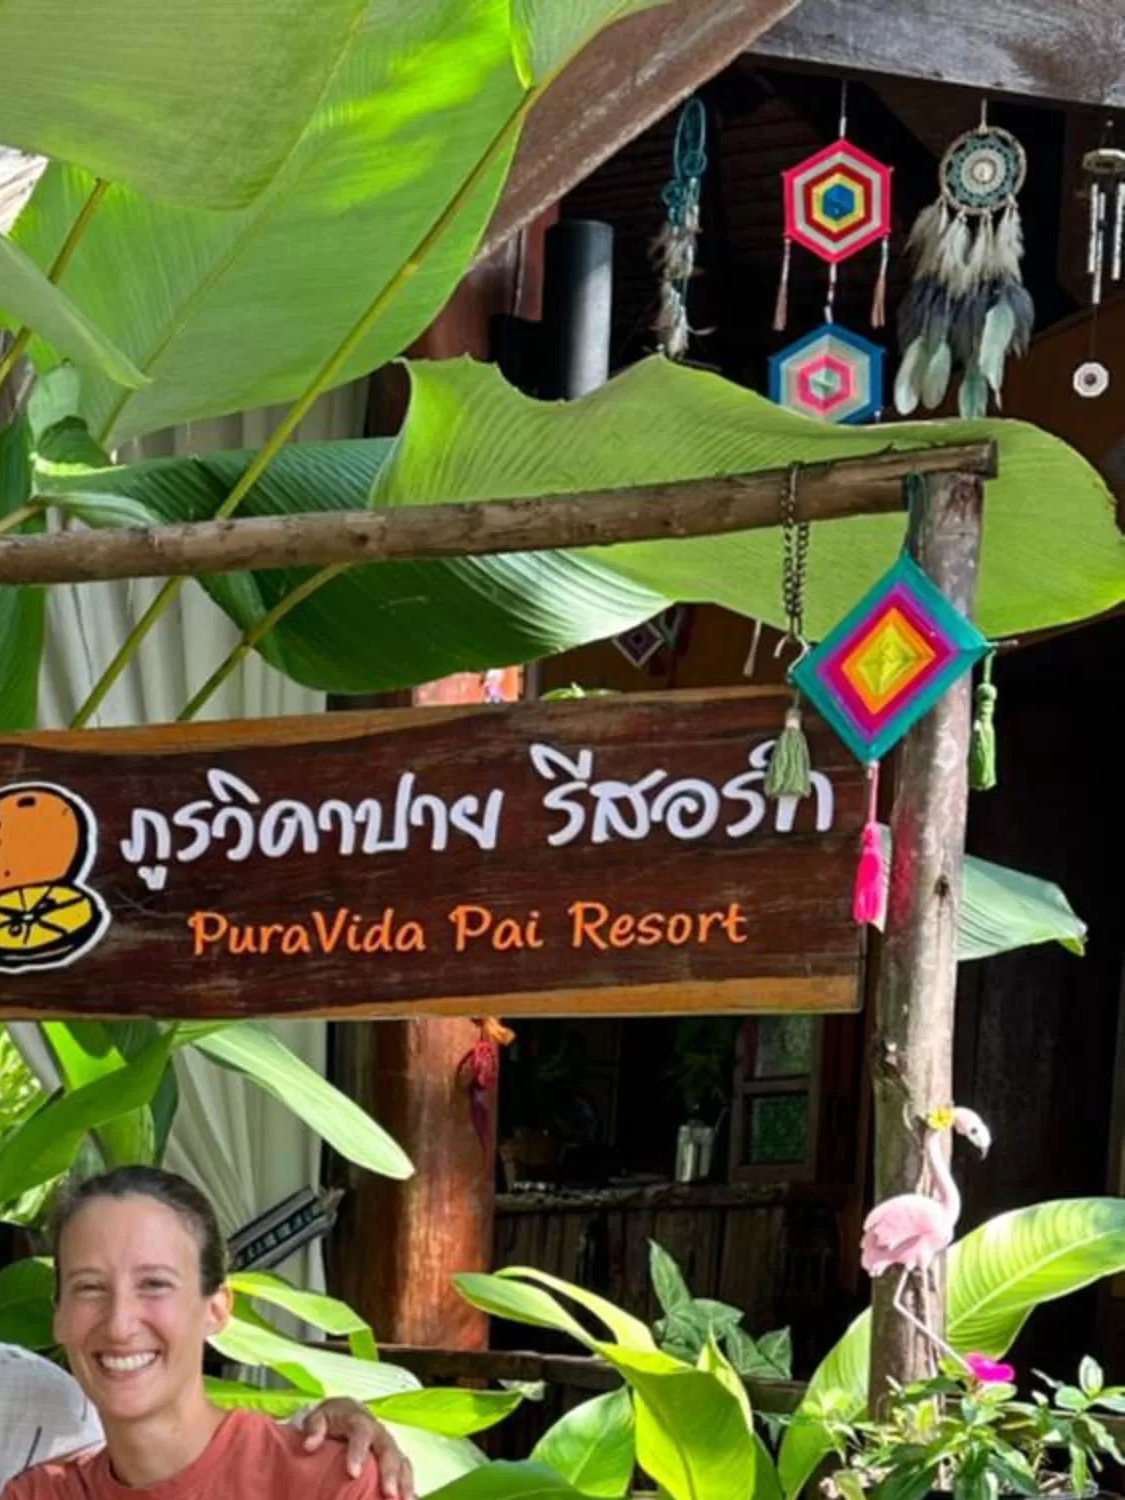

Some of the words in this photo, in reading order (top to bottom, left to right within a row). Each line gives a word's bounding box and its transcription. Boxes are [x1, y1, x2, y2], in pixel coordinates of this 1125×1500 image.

[119, 768, 505, 891] ภูรวิดาปาย
[187, 907, 426, 955] PuraVida
[448, 904, 543, 951] Pai
[568, 901, 748, 950] Resort
